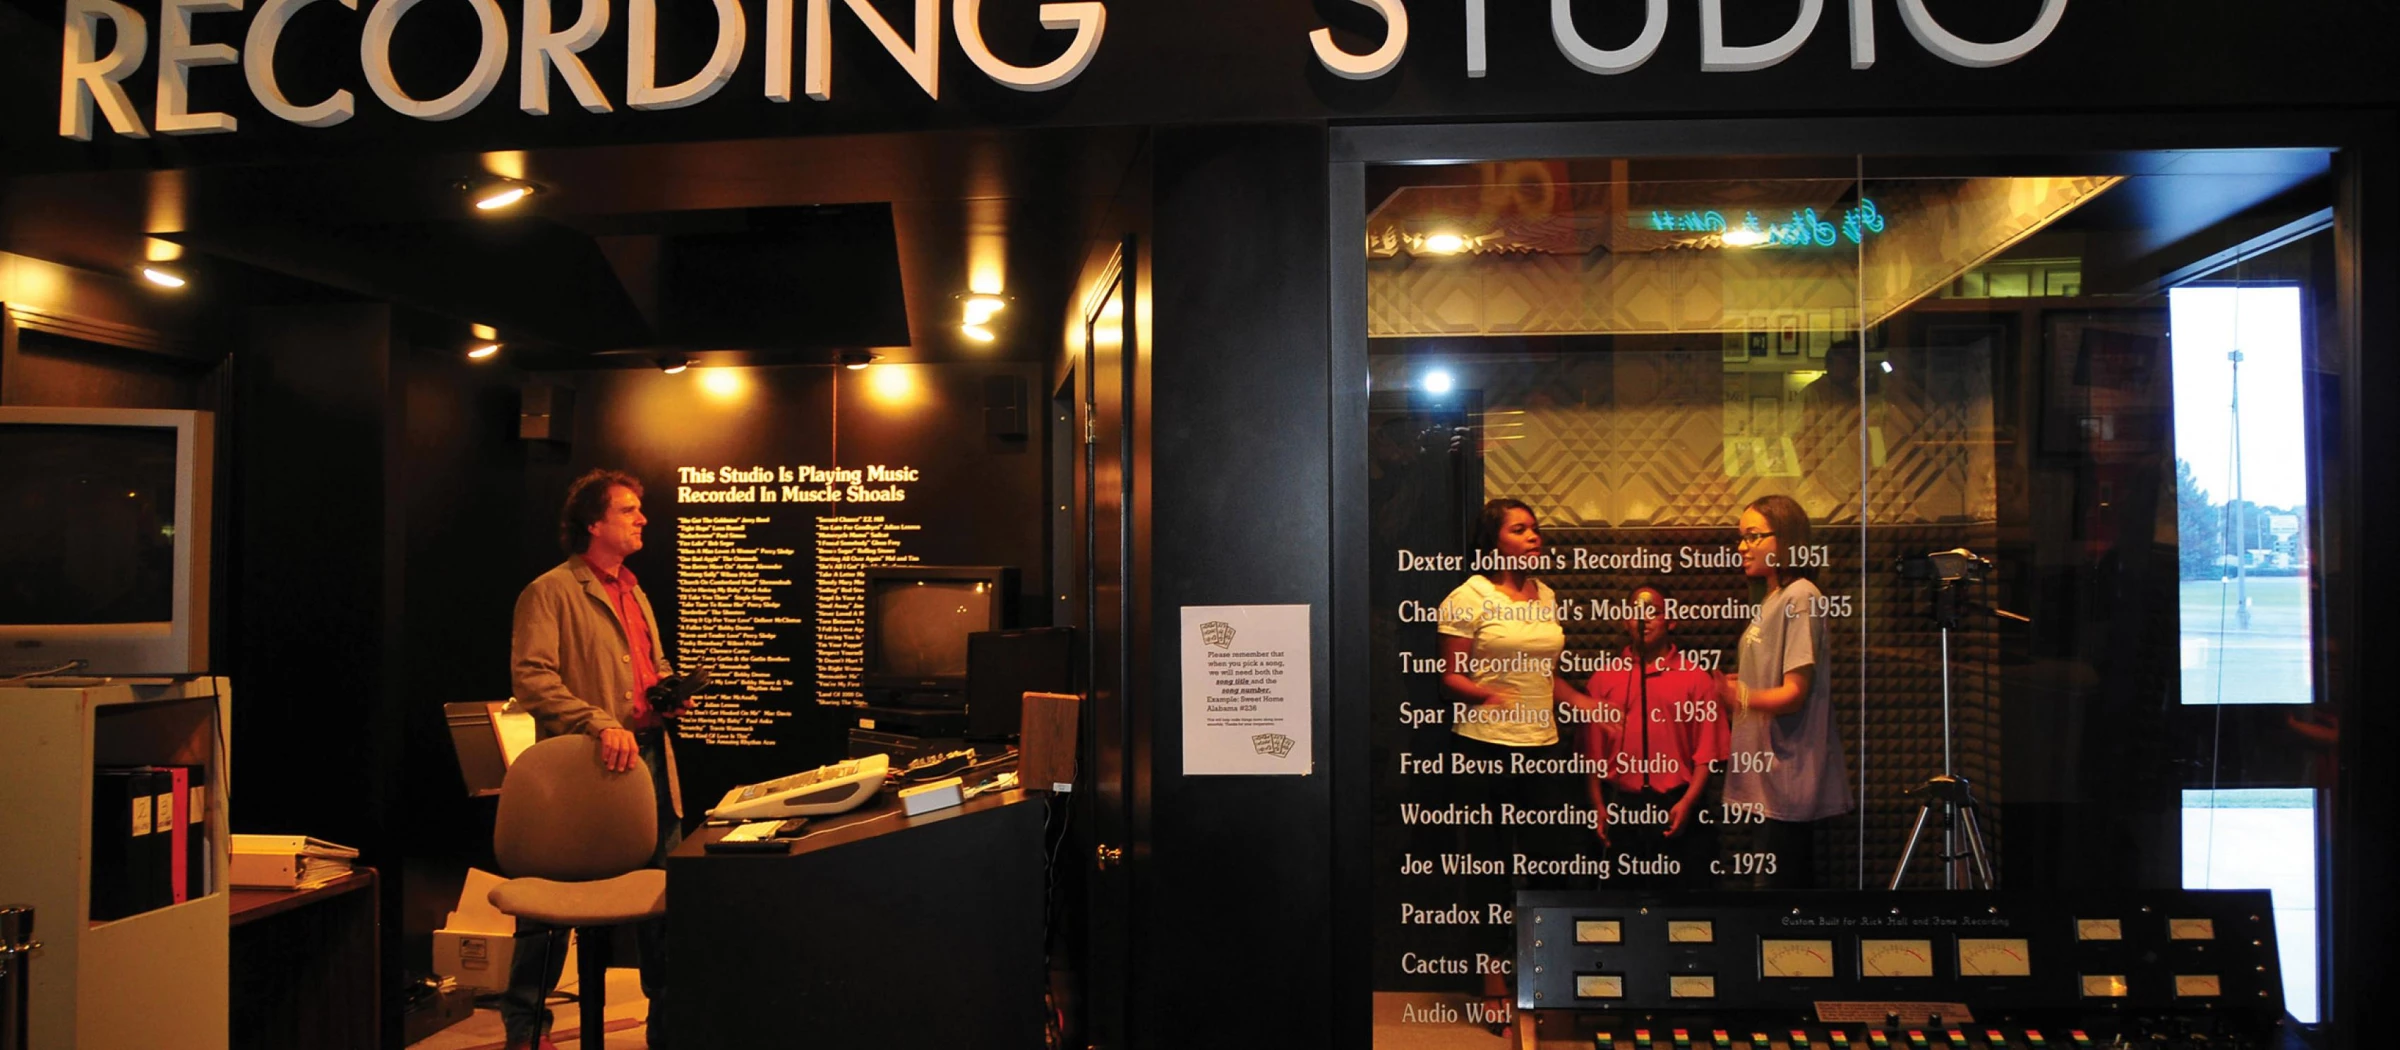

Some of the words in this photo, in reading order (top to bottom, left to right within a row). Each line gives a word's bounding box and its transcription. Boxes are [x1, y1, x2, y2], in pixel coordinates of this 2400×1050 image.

[59, 0, 1106, 141] RECORDING
[677, 467, 715, 483] This
[719, 466, 774, 483] Studio
[778, 466, 794, 483] Is
[798, 465, 862, 487] Playing
[867, 465, 919, 482] Music
[677, 486, 755, 503] Recorded
[760, 486, 777, 502] In
[781, 485, 841, 502] Muscle
[846, 484, 905, 502] Shoals
[1398, 549, 1463, 572] Dexter
[1470, 548, 1567, 571] Johnson's
[1573, 547, 1673, 573] Recording
[1765, 551, 1781, 568] c.
[1788, 546, 1830, 568] 1951
[1398, 600, 1474, 623] Charles
[1481, 599, 1583, 622] Stanfield's
[1590, 599, 1657, 621] Mobile
[1663, 598, 1762, 623] Recording
[1785, 603, 1800, 619] c.
[1808, 596, 1853, 618] 1955
[1242, 660, 1258, 668] pick
[1399, 651, 1447, 674] Tune
[1454, 651, 1553, 676] Recording
[1559, 651, 1633, 673] Studios
[1655, 655, 1671, 673] c.
[1678, 650, 1722, 672] 1957
[1206, 696, 1240, 704] Example:
[1240, 687, 1271, 695] number.
[1399, 704, 1445, 729] Spar
[1453, 703, 1551, 729] Recording
[1558, 702, 1621, 724] Studio
[1651, 707, 1667, 723] c.
[1673, 701, 1718, 723] 1958
[1399, 753, 1444, 775] Fred
[1510, 753, 1610, 778] Recording
[1615, 752, 1680, 774] Studio
[1708, 757, 1725, 774] c.
[1731, 752, 1775, 774] 1967
[1400, 803, 1493, 826] Woodrich
[1500, 803, 1599, 830] Recording
[1605, 803, 1670, 825] Studio
[1698, 807, 1715, 825] c.
[1722, 803, 1766, 825] 1973
[1400, 854, 1434, 876] Joe
[1440, 853, 1506, 875] Wilson
[1512, 853, 1610, 879] Recording
[1617, 853, 1682, 876] Studio
[1710, 858, 1726, 876] c.
[1733, 853, 1778, 875] 1973
[1401, 903, 1481, 926] Paradox
[1781, 917, 1816, 927] Custom
[1818, 917, 1840, 927] Built
[1843, 917, 1856, 927] for
[1912, 917, 1929, 927] and
[1401, 953, 1468, 975] Cactus
[1401, 1003, 1459, 1025] Audio
